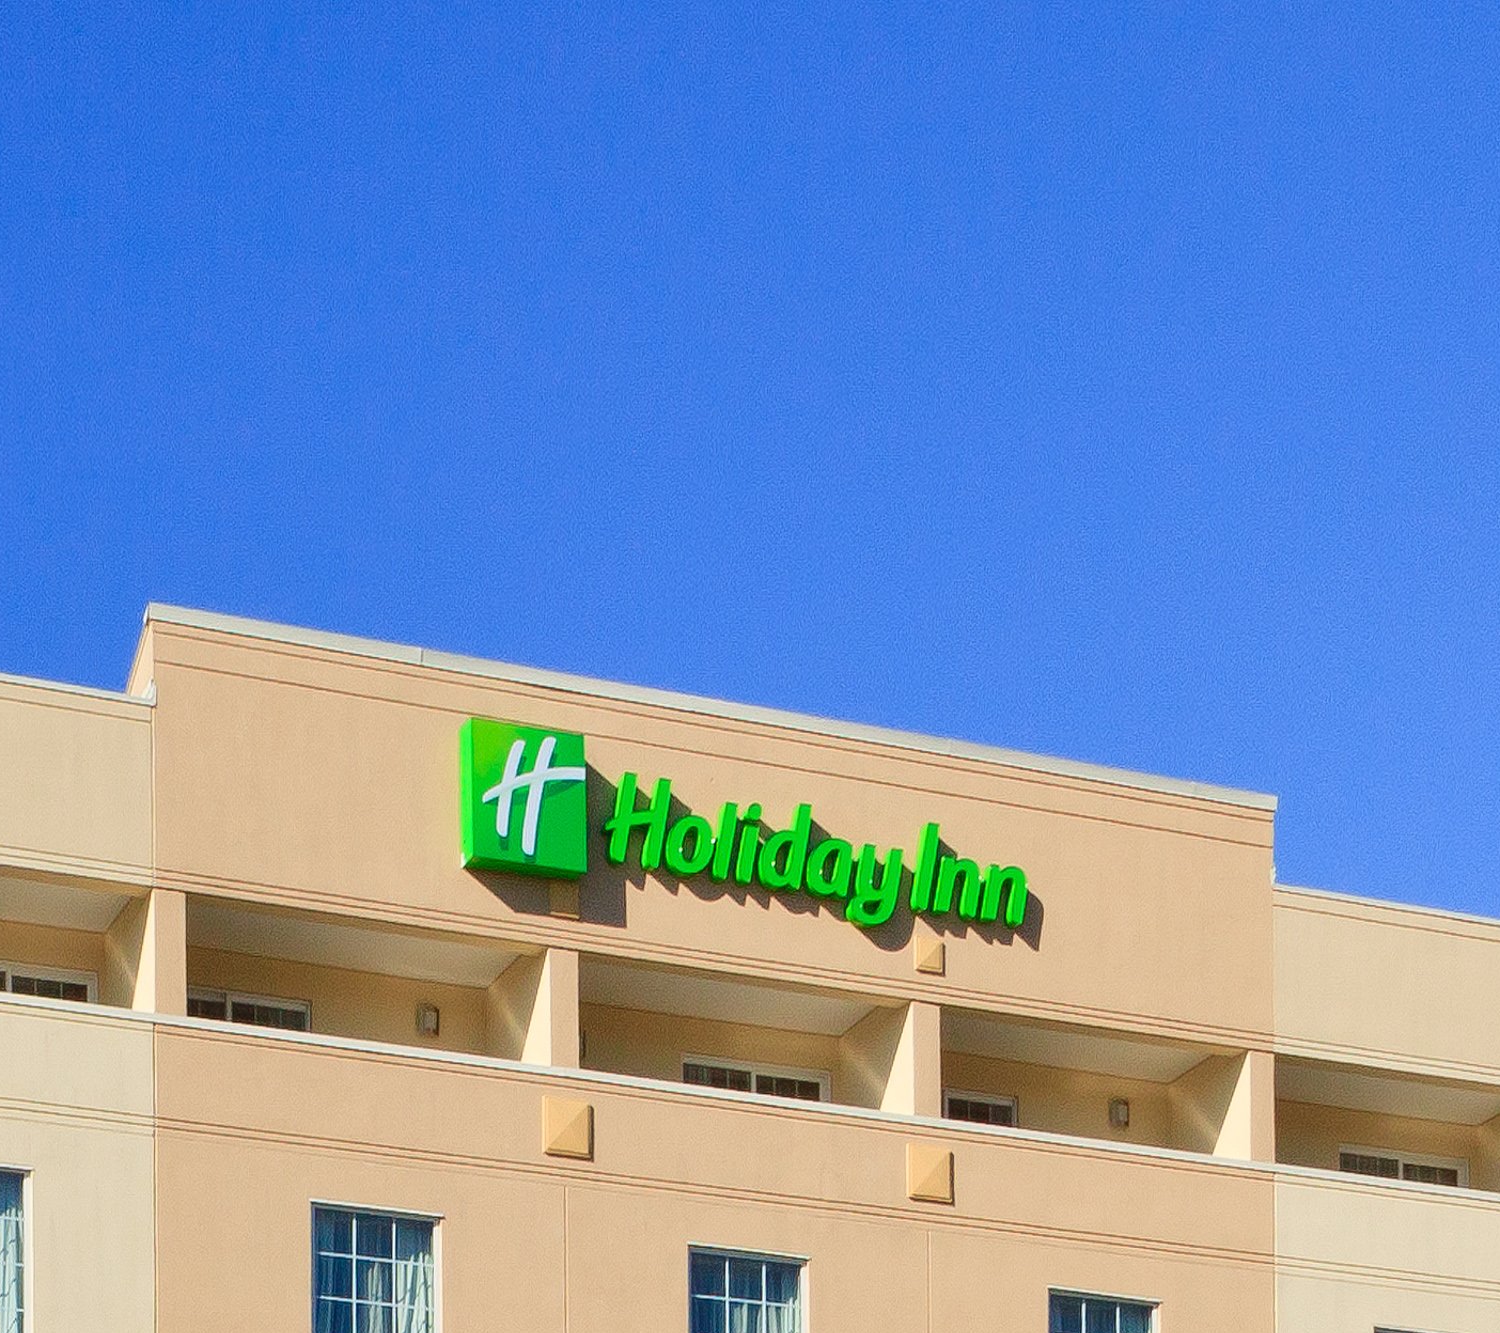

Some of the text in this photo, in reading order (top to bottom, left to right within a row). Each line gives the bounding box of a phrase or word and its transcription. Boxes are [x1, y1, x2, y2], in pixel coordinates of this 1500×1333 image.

[482, 736, 586, 856] H
[604, 772, 1028, 927] Holiday Inn
